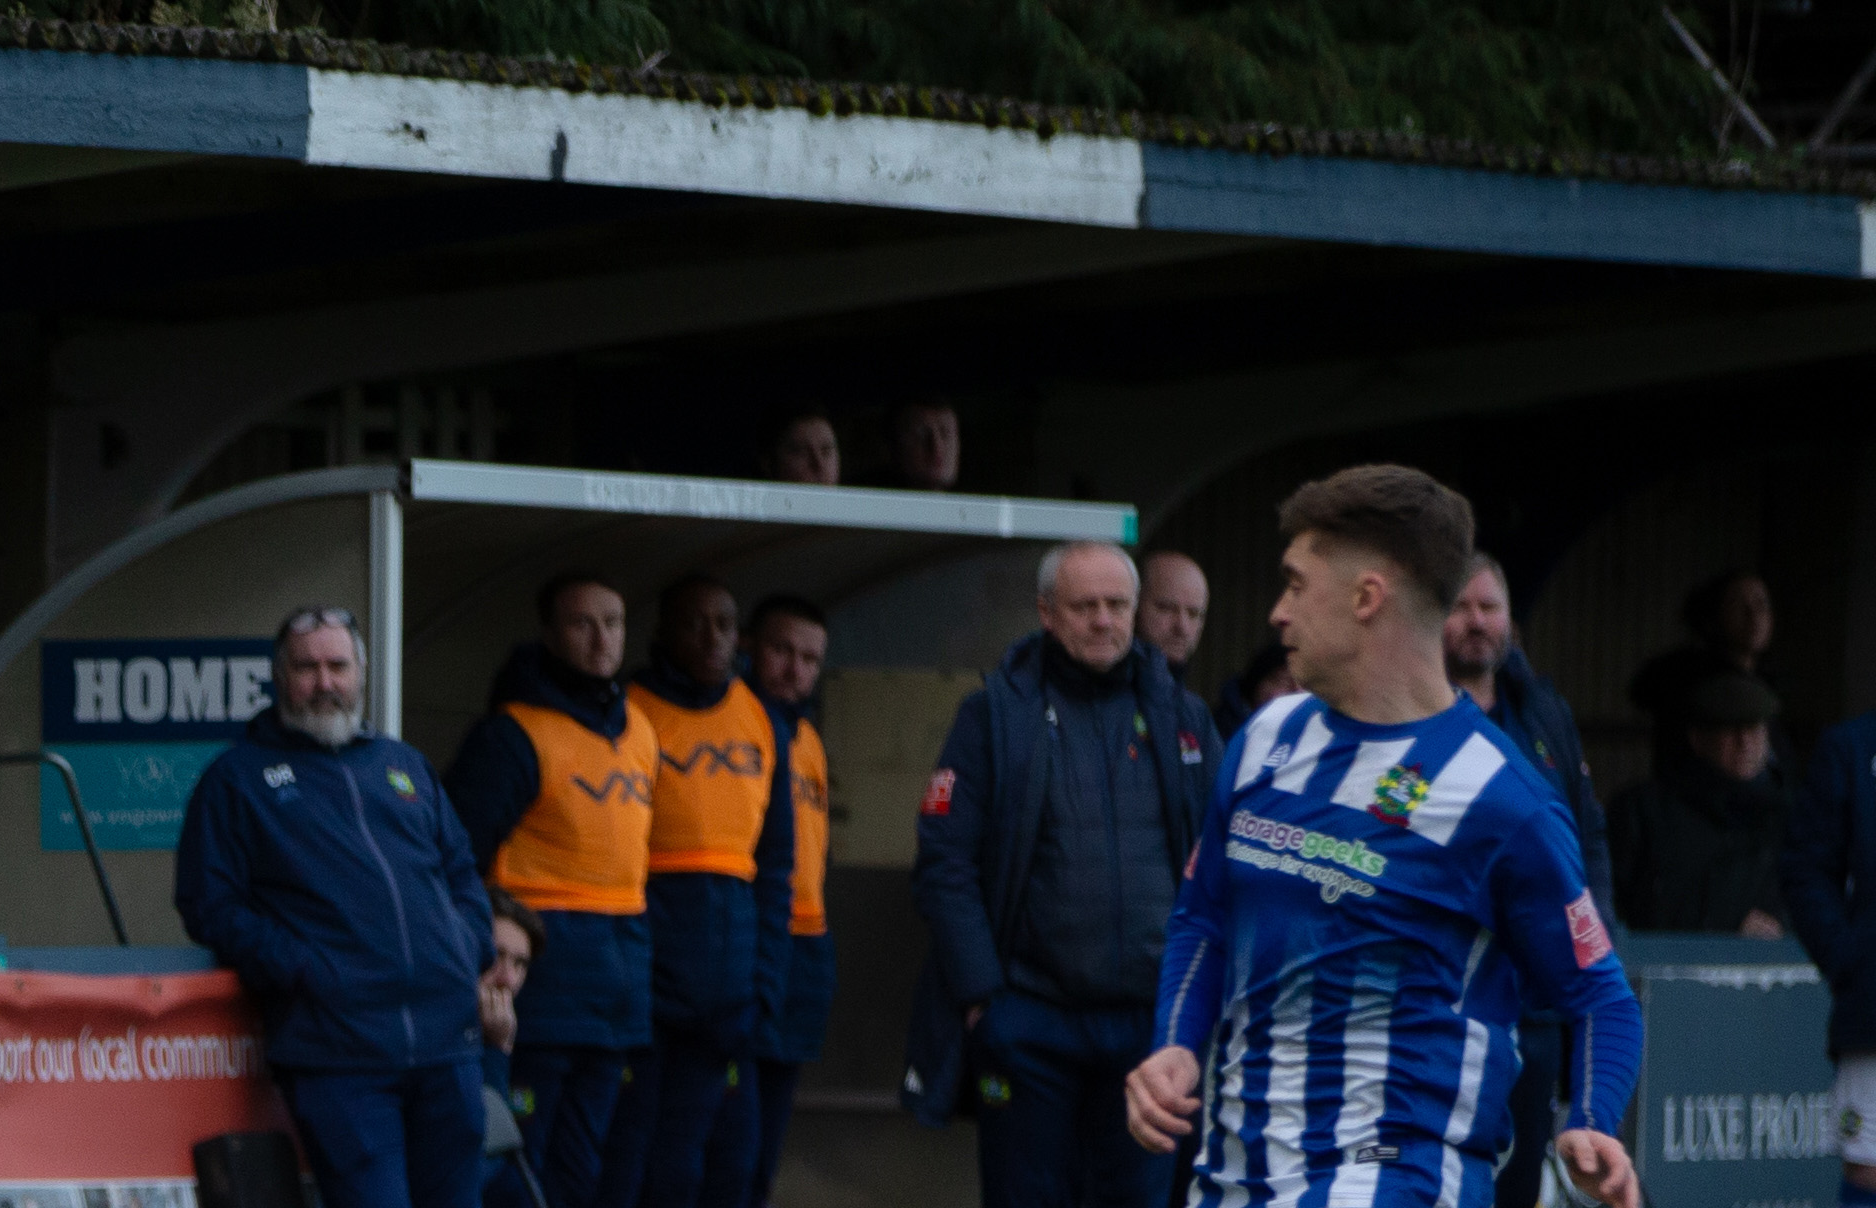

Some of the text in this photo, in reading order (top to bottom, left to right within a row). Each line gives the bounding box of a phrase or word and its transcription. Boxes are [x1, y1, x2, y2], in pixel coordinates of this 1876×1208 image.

[75, 656, 273, 724] HOME
[35, 1036, 76, 1083] our
[79, 1024, 143, 1083] local
[142, 1034, 260, 1080] commun
[1663, 1095, 1745, 1162] LUXE
